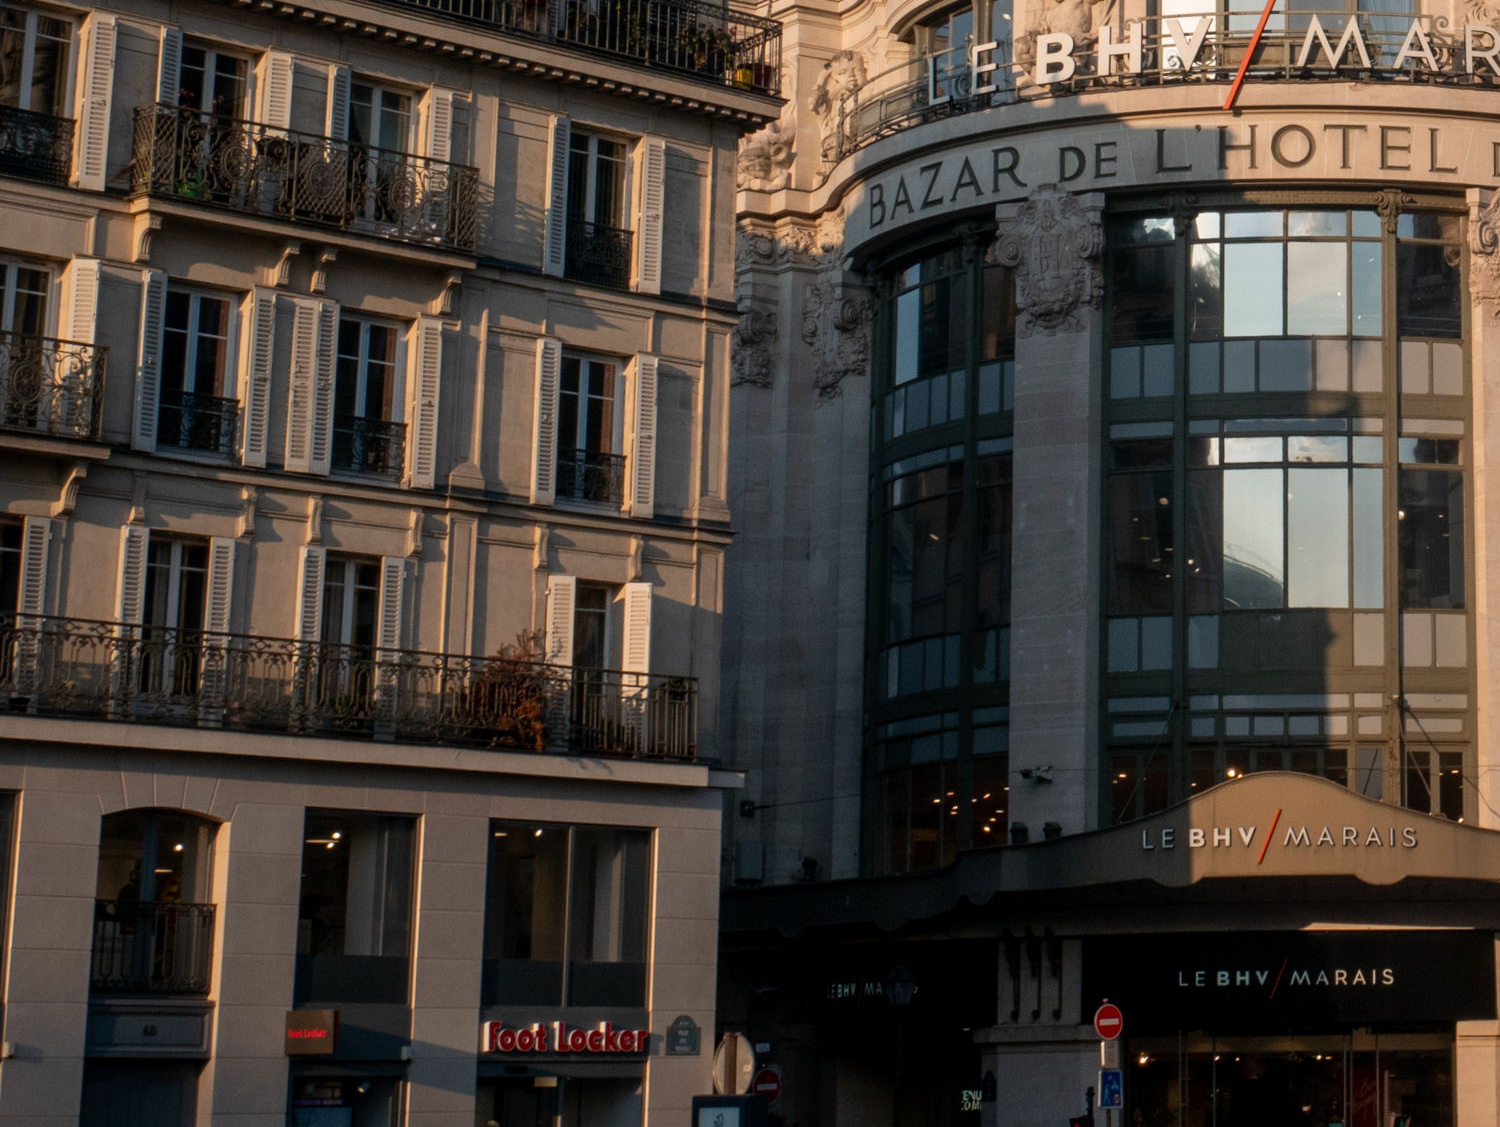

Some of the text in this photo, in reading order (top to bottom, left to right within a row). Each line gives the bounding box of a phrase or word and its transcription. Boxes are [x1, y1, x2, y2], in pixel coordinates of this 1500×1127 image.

[928, 41, 999, 106] LE
[868, 146, 1027, 229] BAZAR
[1058, 141, 1118, 183] DE
[1155, 124, 1458, 174] L'HOTEL
[1142, 828, 1175, 849] LE
[1178, 970, 1206, 987] LE
[483, 1021, 648, 1053] Foot Locker
